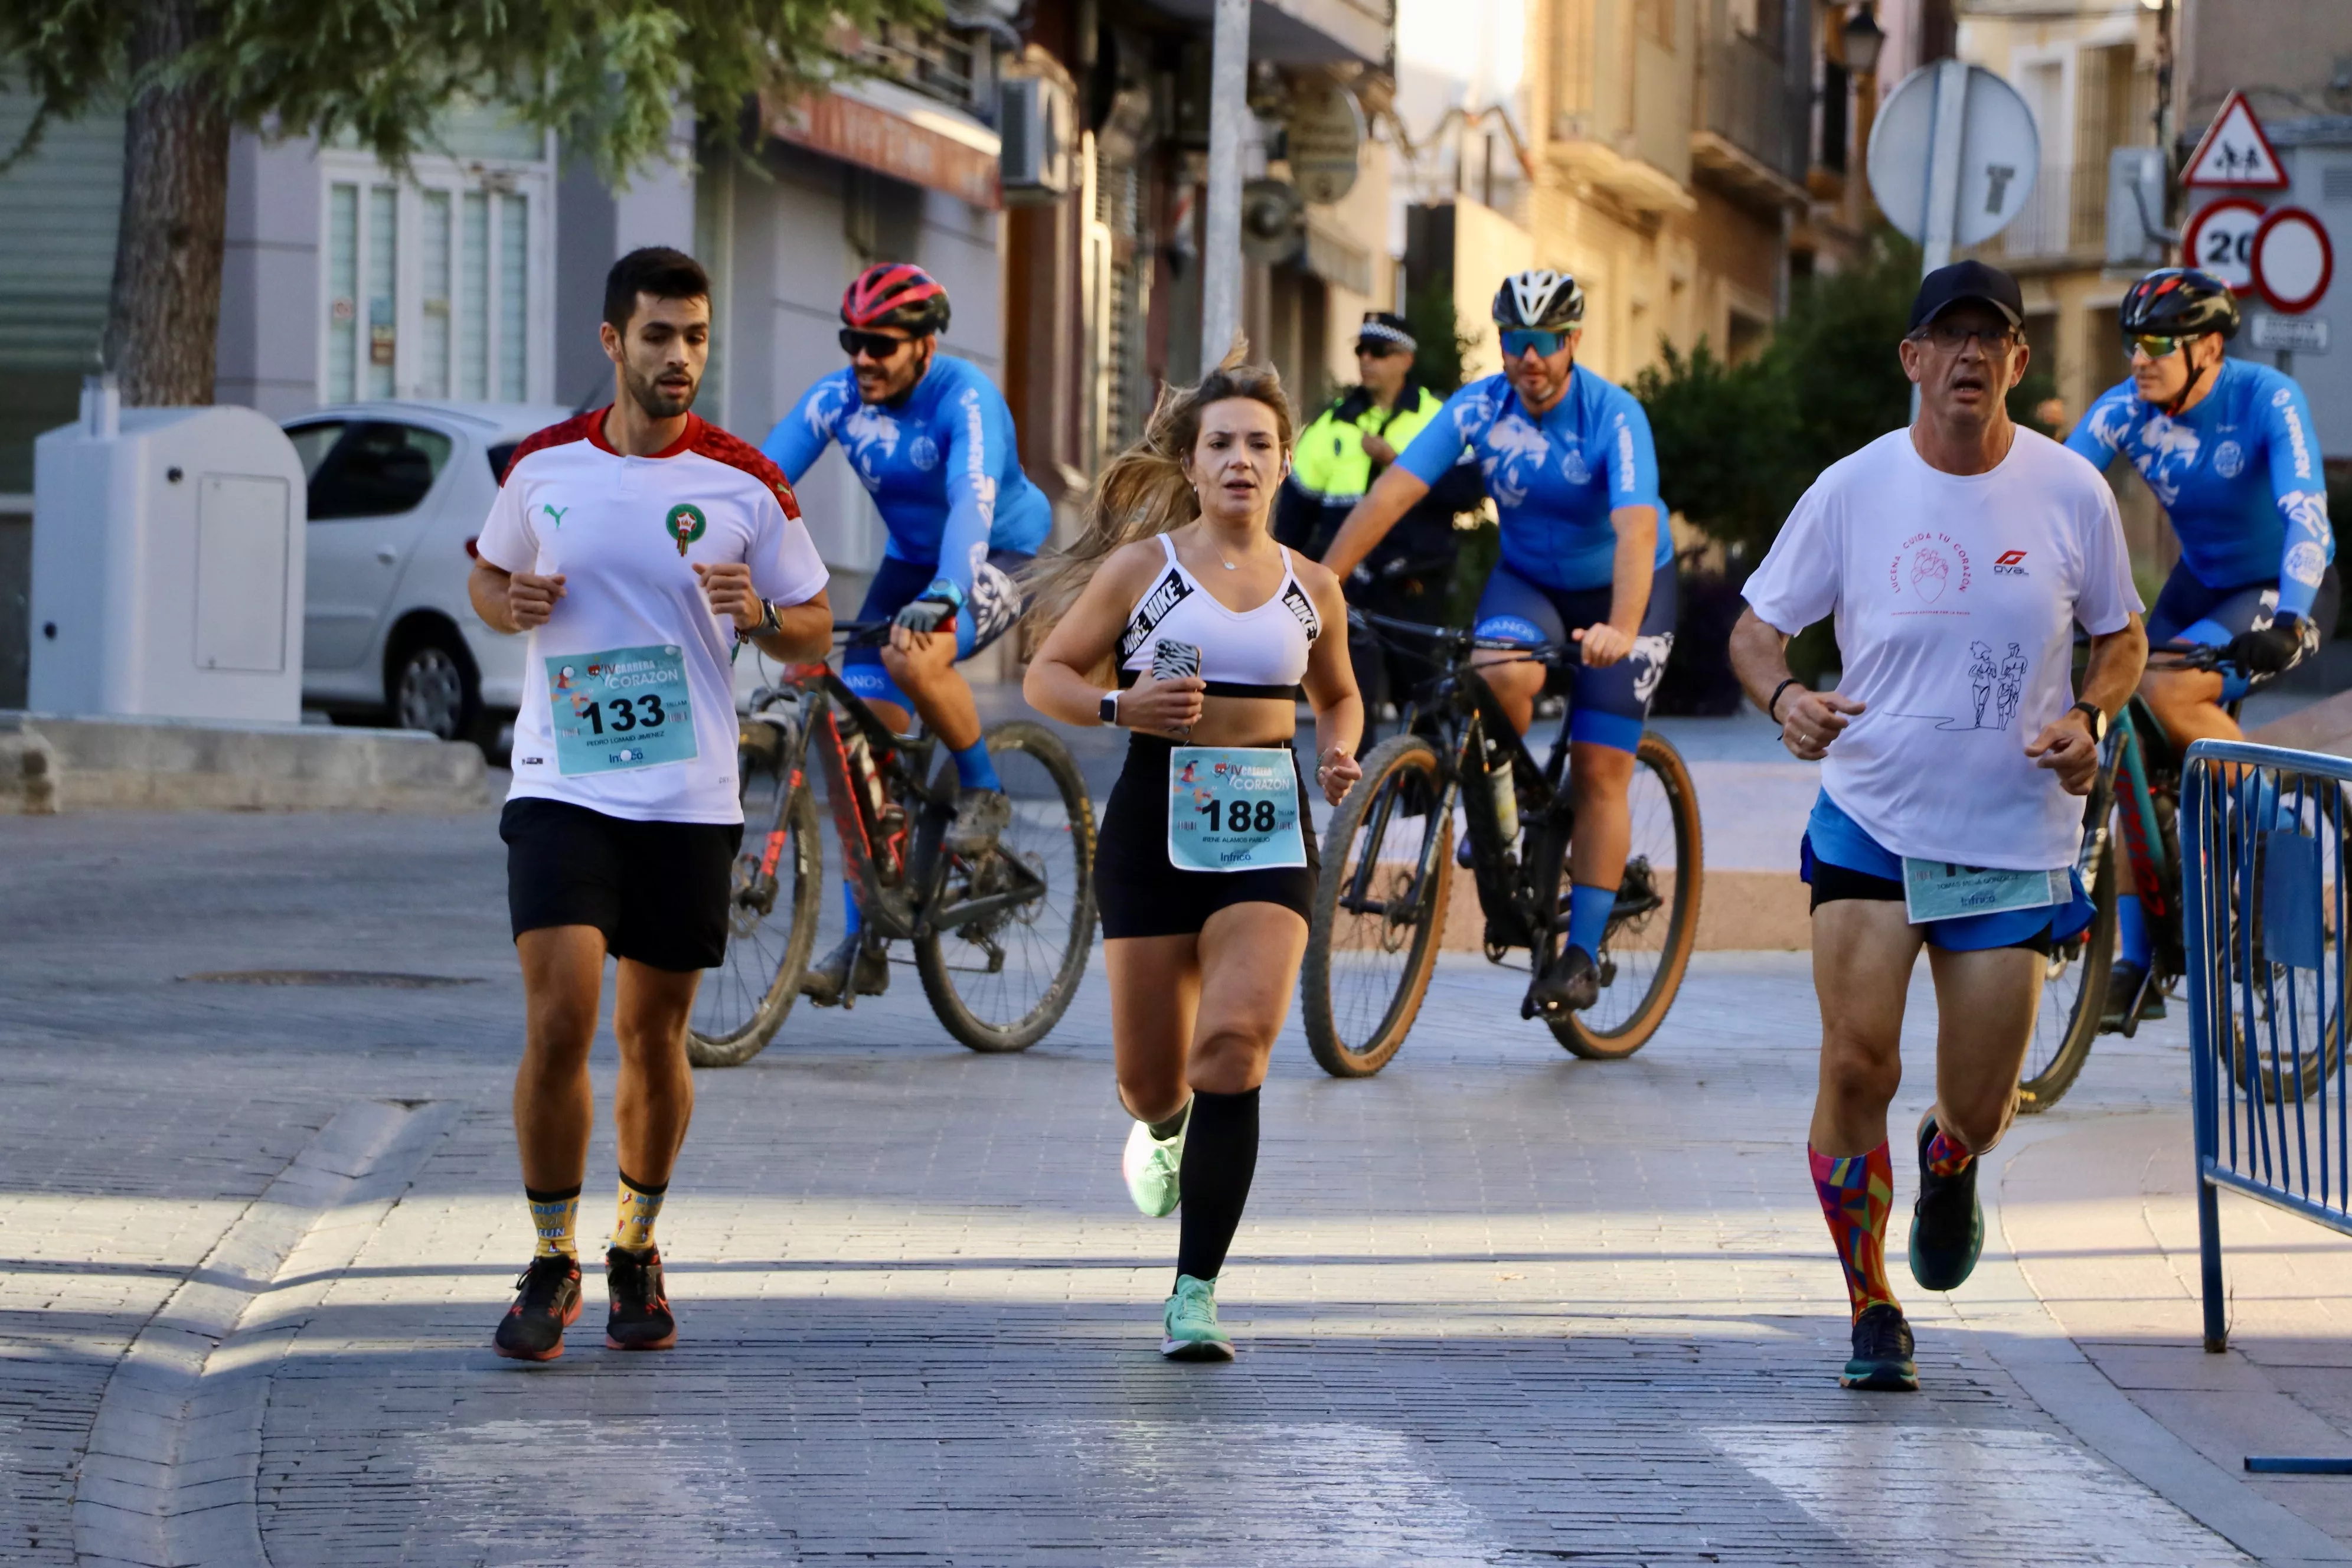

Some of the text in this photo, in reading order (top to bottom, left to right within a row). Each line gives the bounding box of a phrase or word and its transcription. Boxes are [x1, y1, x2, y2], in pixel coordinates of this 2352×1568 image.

[1890, 556, 1901, 593] LUCENA
[1903, 533, 1931, 548] CUIDA
[1939, 533, 1951, 543] TU
[1143, 579, 1180, 627] NIKE
[1285, 593, 1317, 634] NIKE
[616, 660, 655, 675] CARRERA
[583, 694, 665, 734] 133
[1202, 799, 1276, 832] 188
[1220, 852, 1252, 862] Infrico
[538, 1228, 565, 1239] FUN
